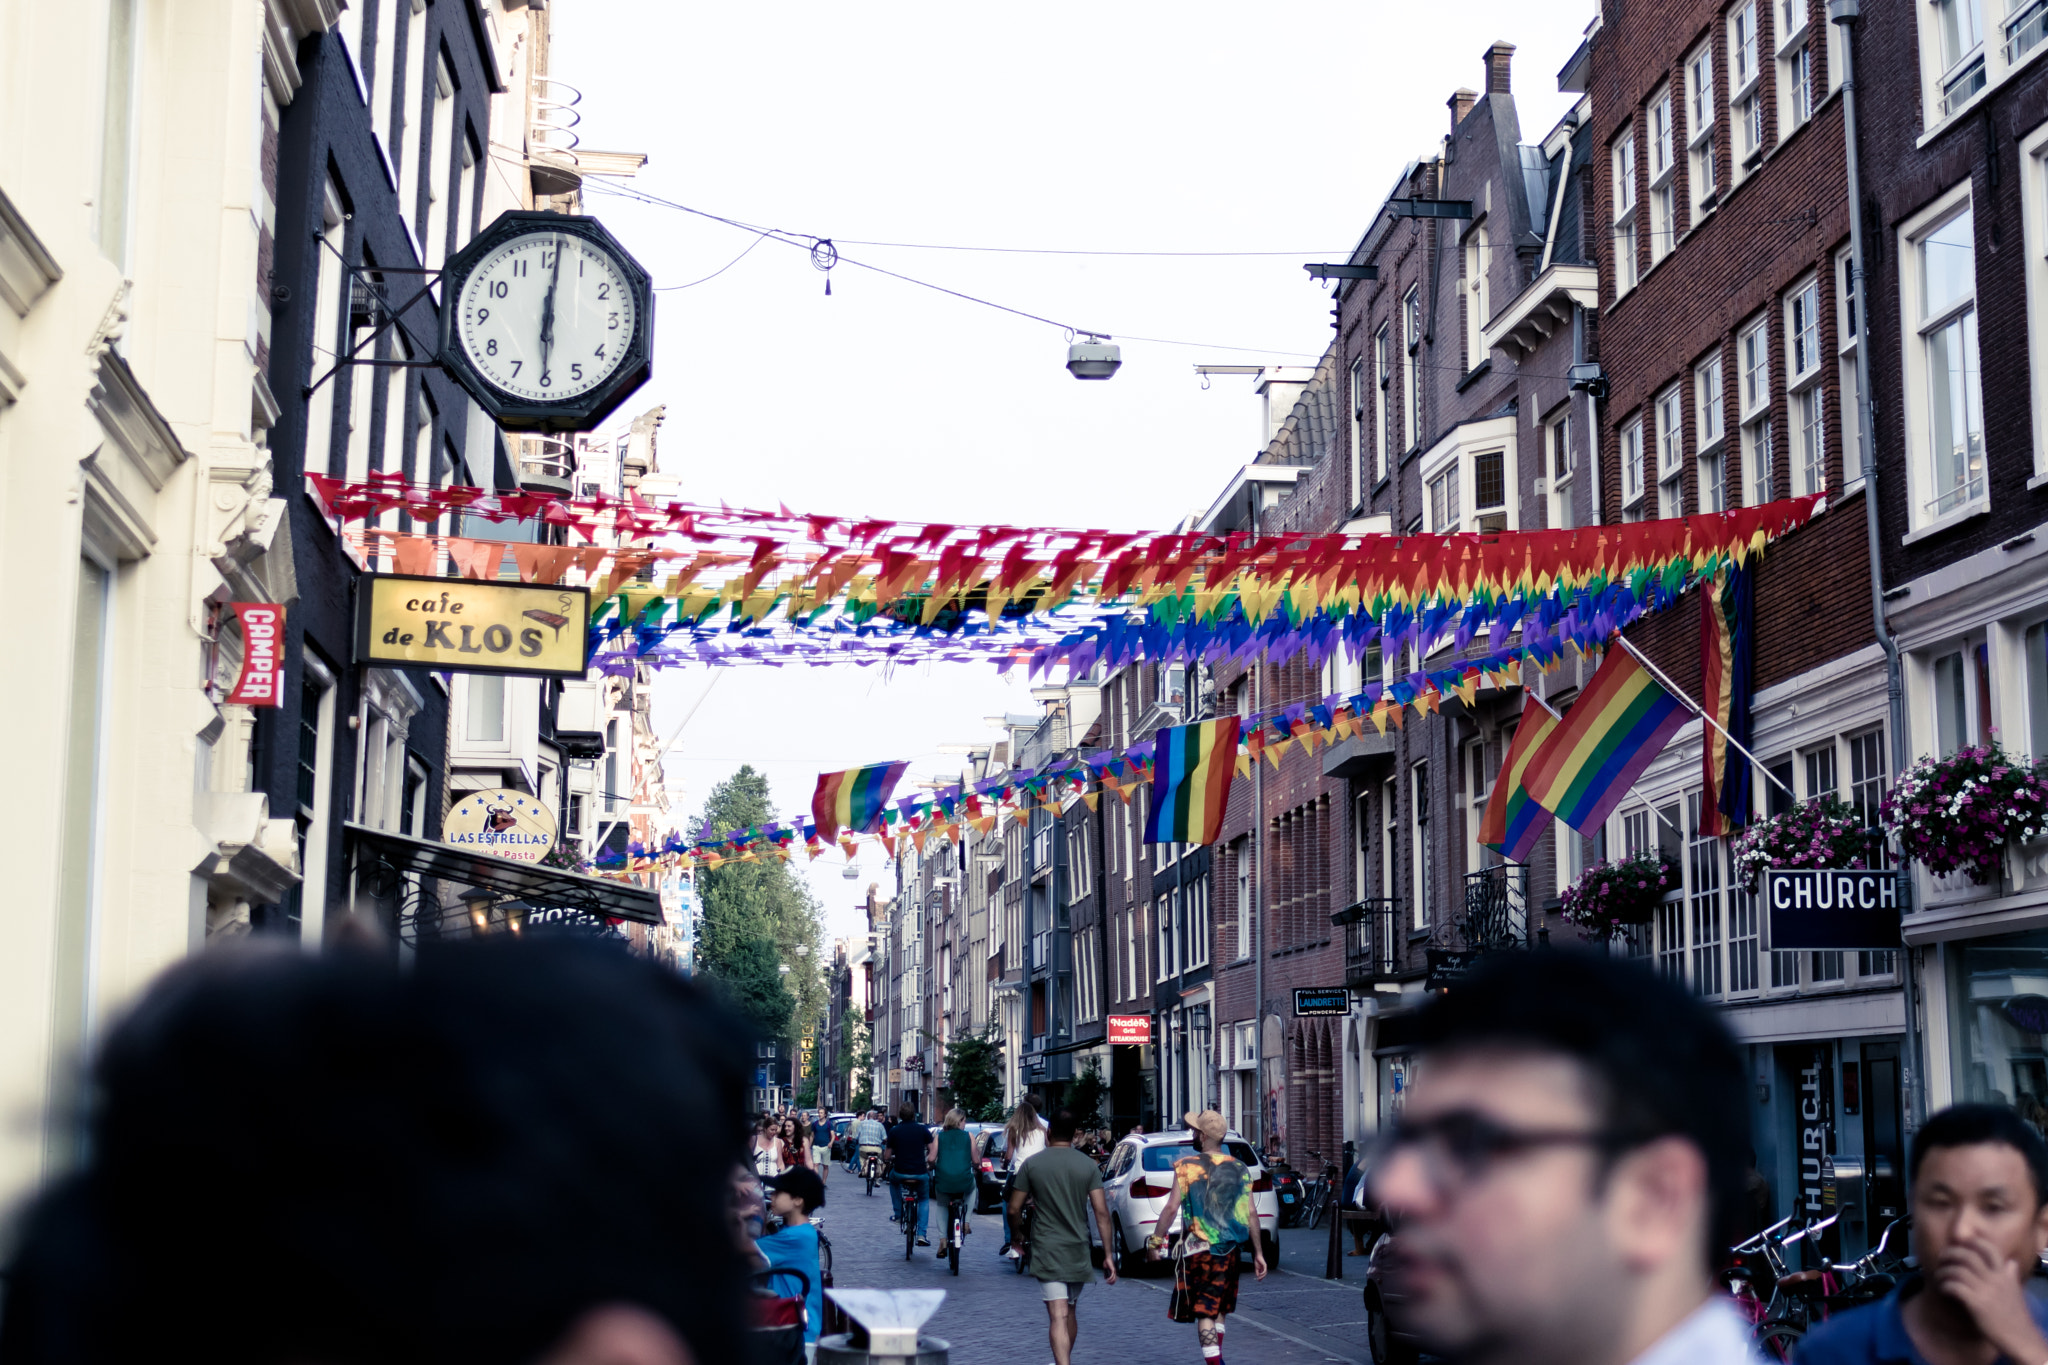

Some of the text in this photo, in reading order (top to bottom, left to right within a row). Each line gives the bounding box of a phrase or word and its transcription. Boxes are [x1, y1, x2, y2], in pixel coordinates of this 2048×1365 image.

[514, 260, 527, 277] 11
[490, 281, 508, 299] 10
[598, 283, 610, 300] 2
[477, 309, 490, 326] 9
[608, 312, 619, 330] 3
[486, 339, 498, 356] 8
[594, 344, 606, 361] 4
[510, 361, 523, 378] 7
[571, 364, 583, 381] 5
[539, 370, 552, 388] 6
[406, 592, 464, 614] cafe
[382, 620, 543, 658] de KLOS
[239, 609, 276, 698] CAMPER
[450, 832, 548, 845] LAS ESTRELLAS
[504, 850, 536, 860] Pasta
[1773, 871, 1897, 910] CHURCH
[1299, 997, 1345, 1007] LAUNDRETTE
[1801, 1068, 1823, 1241] CHURCH
